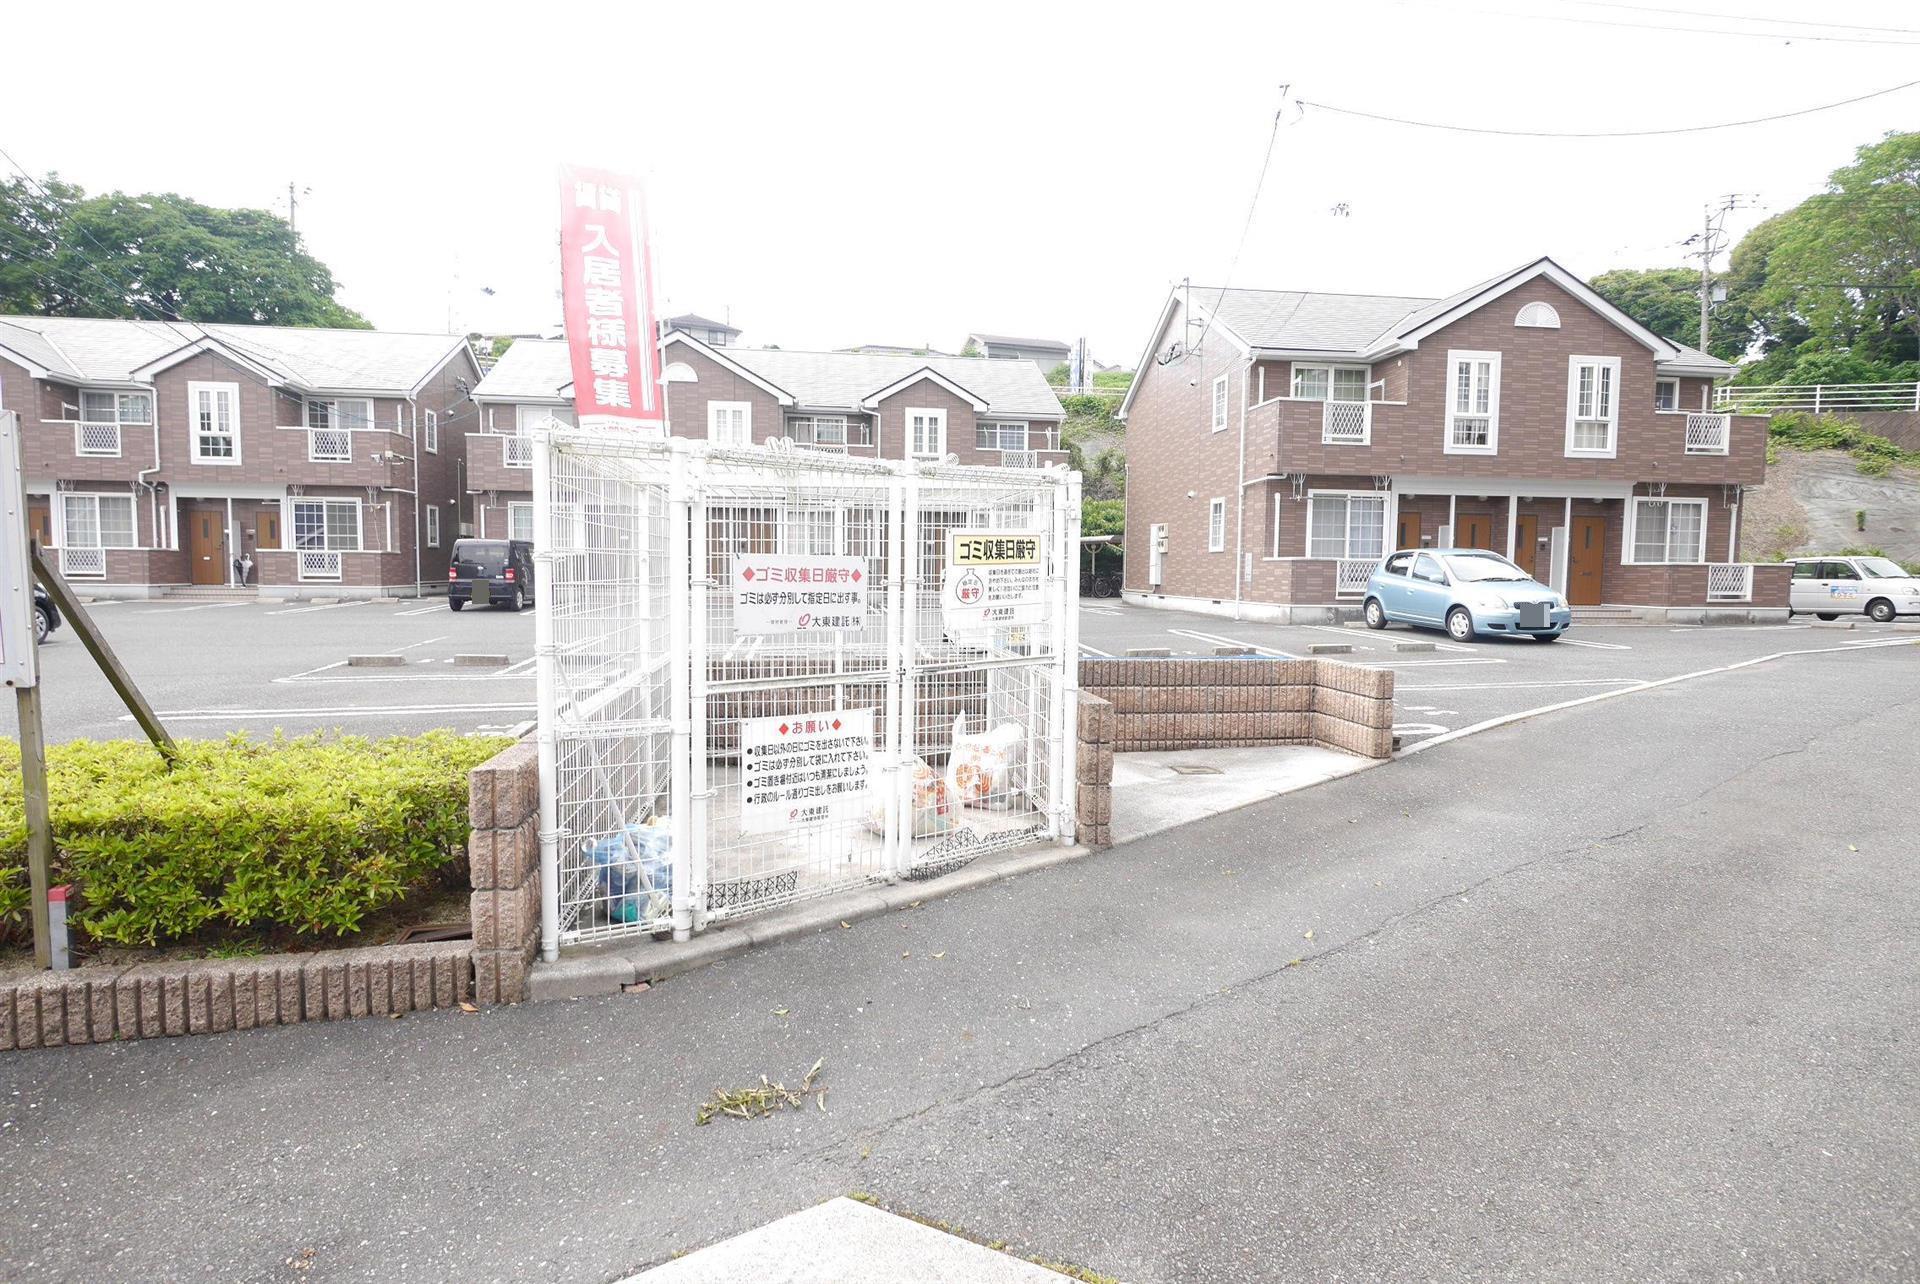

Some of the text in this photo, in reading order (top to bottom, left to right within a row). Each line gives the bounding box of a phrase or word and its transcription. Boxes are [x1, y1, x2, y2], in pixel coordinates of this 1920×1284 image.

[581, 224, 632, 409] 入居者様募集
[960, 538, 1035, 560] ゴミ収集日厳守
[756, 567, 849, 582] ゴミ収集日厳守
[792, 720, 830, 734] お願い
